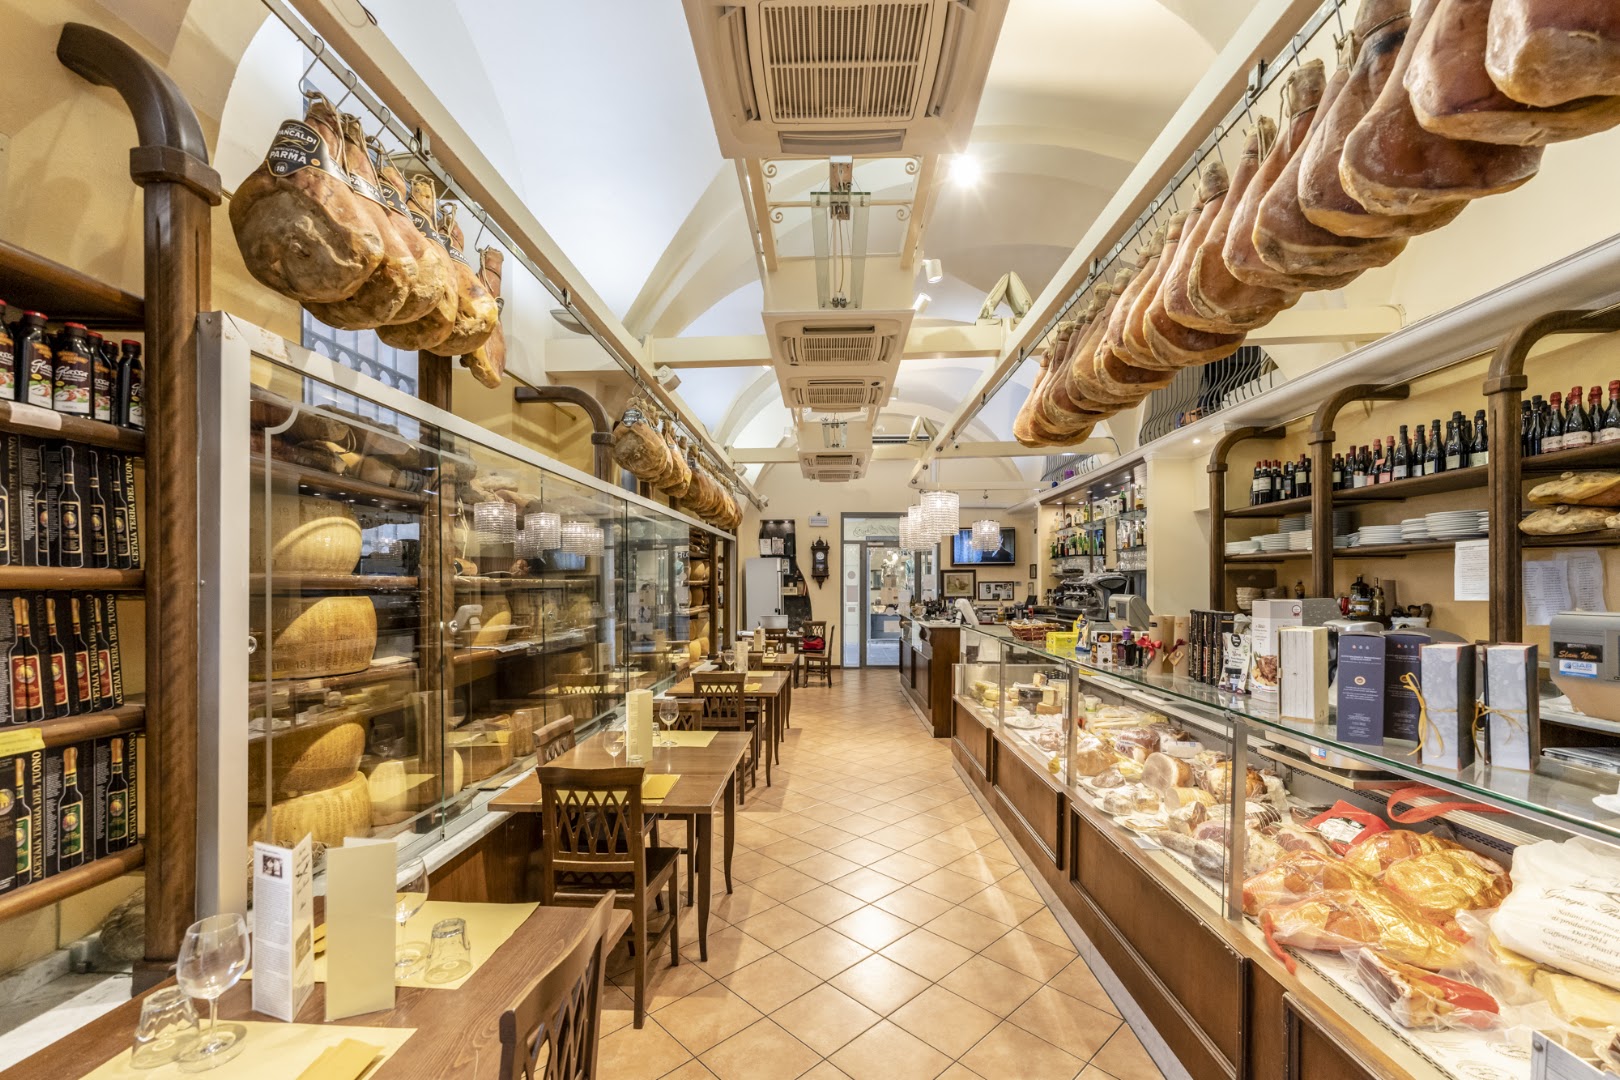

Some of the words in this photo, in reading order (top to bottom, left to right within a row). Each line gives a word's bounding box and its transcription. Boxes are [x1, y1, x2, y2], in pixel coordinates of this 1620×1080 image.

[269, 150, 306, 164] PARMA
[125, 456, 134, 484] TUONO
[128, 503, 137, 530] TERRA
[129, 532, 139, 566] ACETAIA
[107, 594, 116, 623] TUONO
[109, 624, 117, 642] DEL
[110, 643, 120, 670] TERRA
[113, 671, 123, 704] ACETAIA
[128, 732, 136, 761] TUONO
[32, 751, 41, 785] TUONO
[32, 785, 41, 805] DEL
[33, 806, 42, 838] TERRA
[34, 838, 42, 878] ACETAIA
